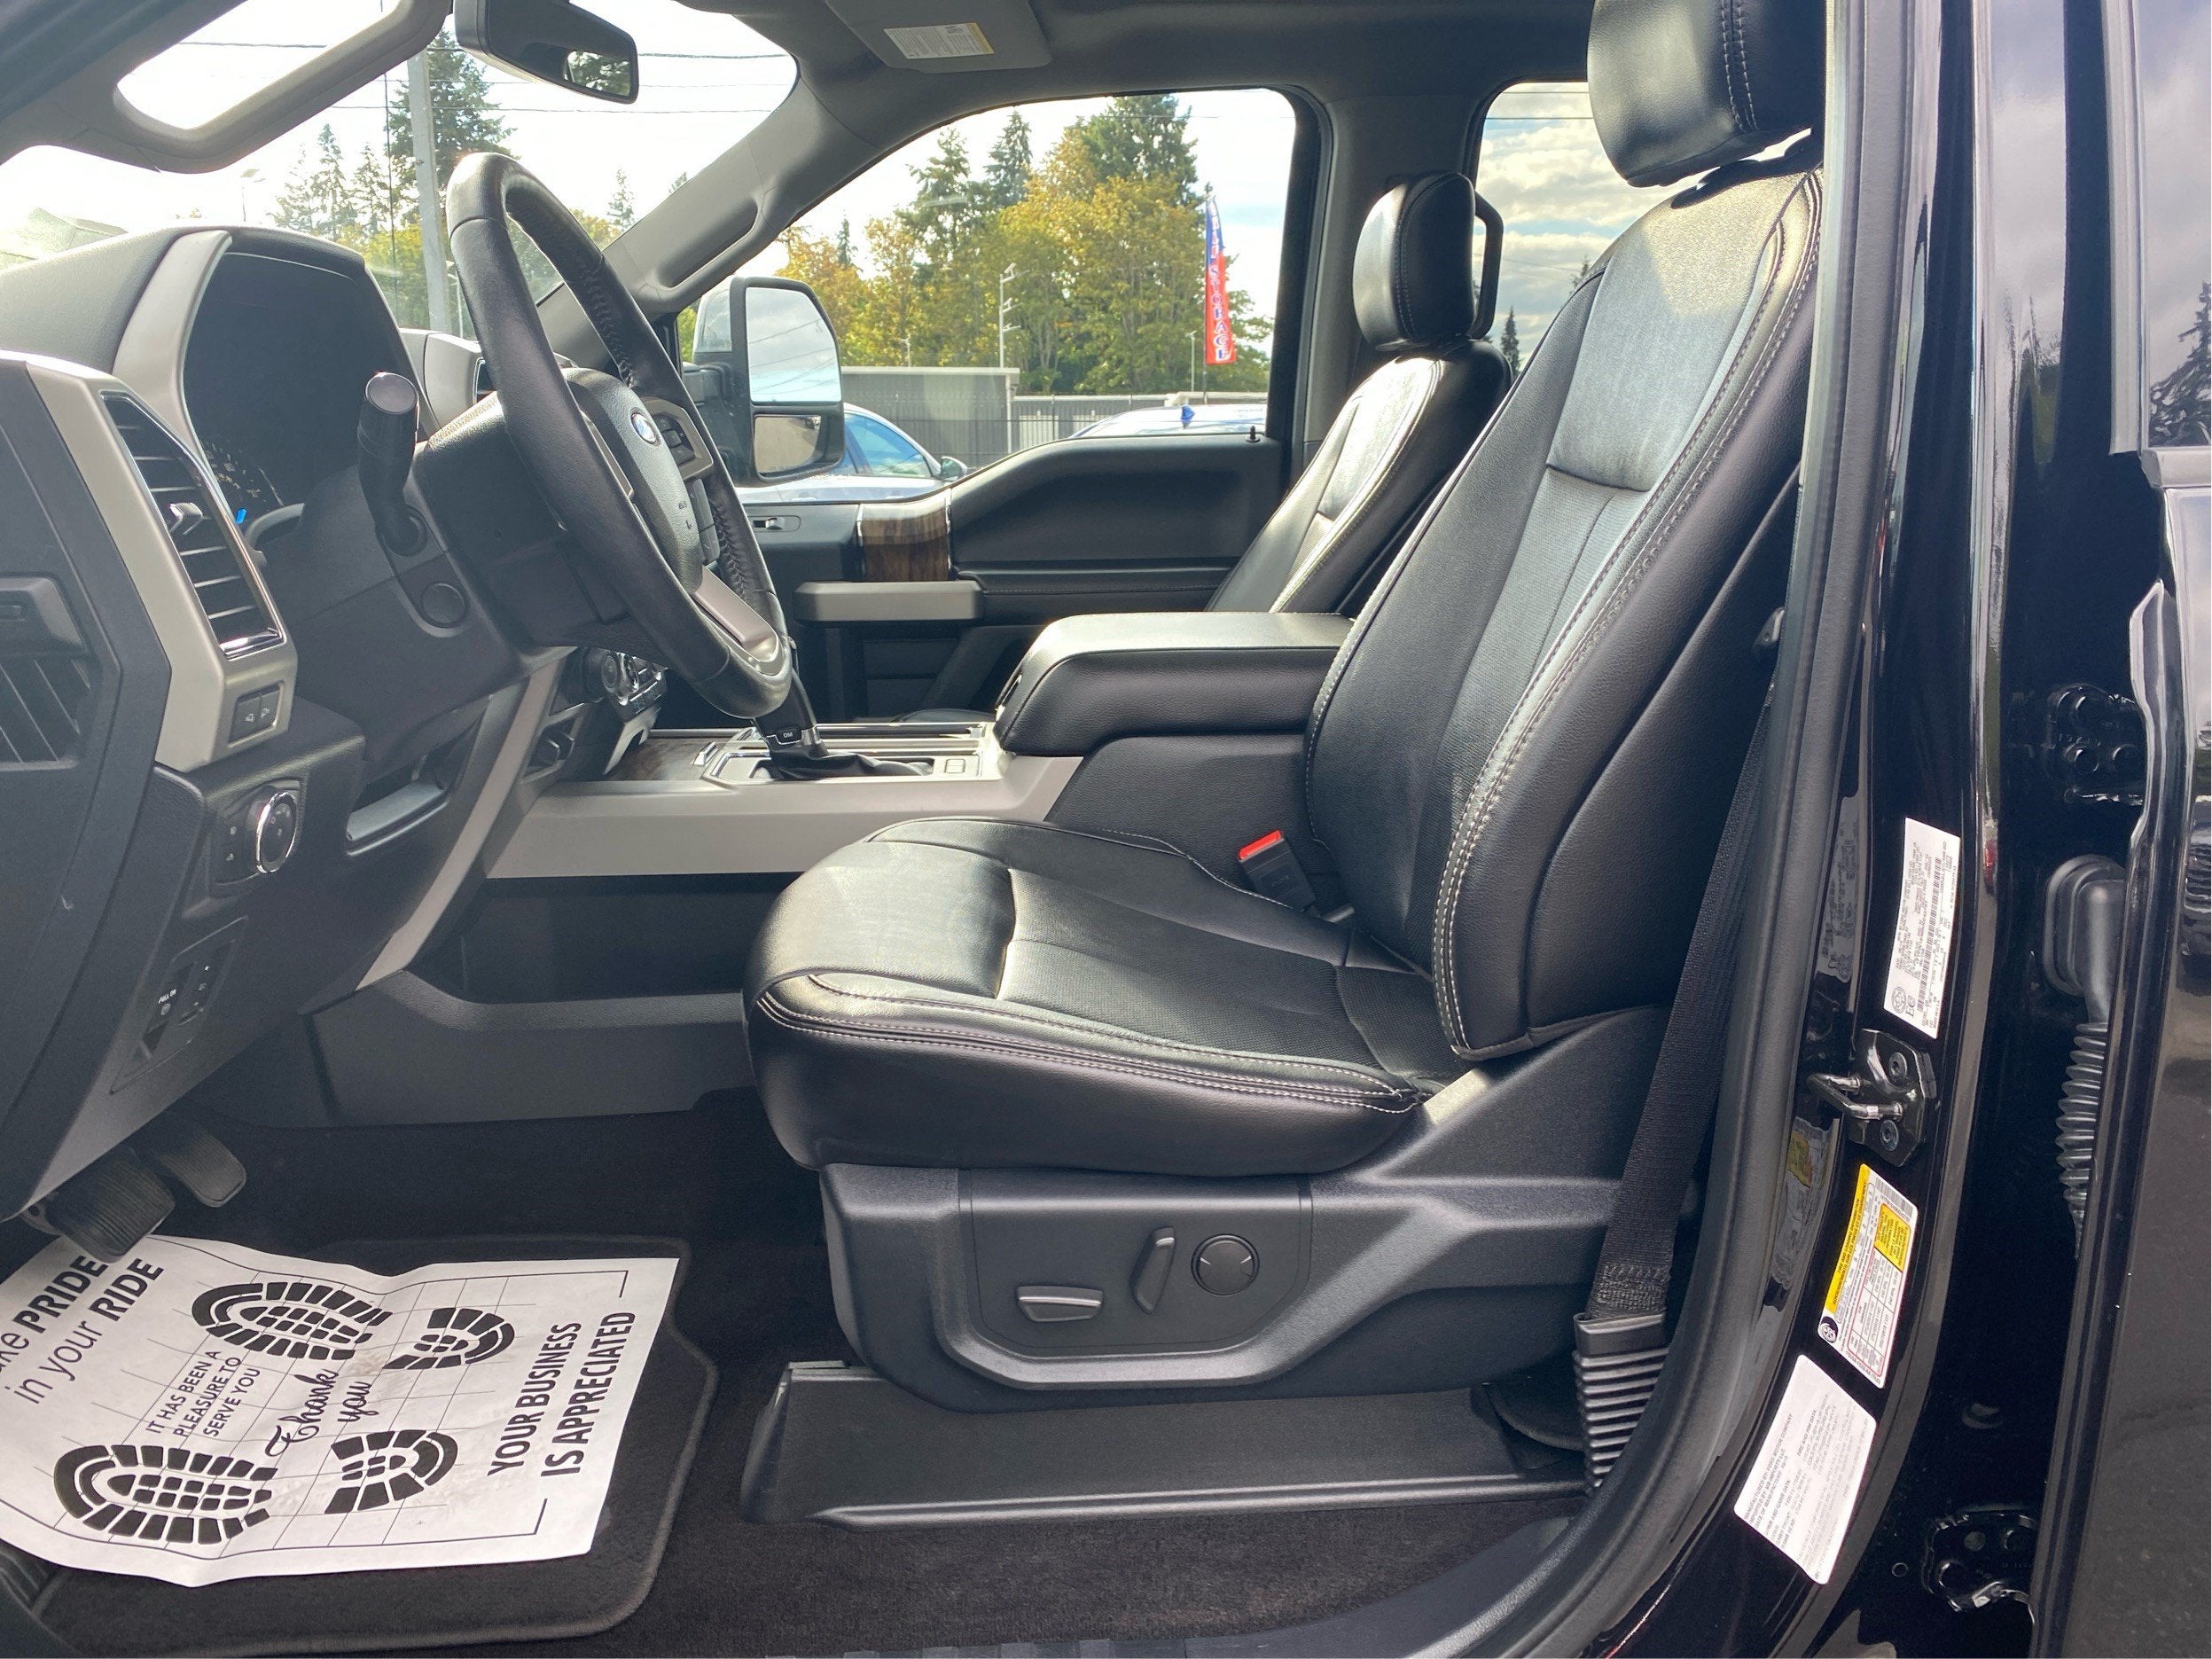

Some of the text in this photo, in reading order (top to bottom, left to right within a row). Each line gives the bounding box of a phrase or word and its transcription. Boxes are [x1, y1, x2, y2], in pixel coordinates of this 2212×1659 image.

[1208, 267, 1231, 362] STORAGE
[4, 1258, 165, 1405] in your RIDE
[13, 1256, 109, 1334] PRIDE
[146, 1350, 222, 1434] IT HAS BEEN A
[173, 1357, 242, 1437] PLEASURE TO
[203, 1368, 261, 1437] SERVE YOU
[265, 1369, 340, 1457] Thank
[337, 1381, 379, 1422] you
[488, 1322, 582, 1476] YOUR BUSINESS
[540, 1311, 636, 1477] IS APPRECIATED
